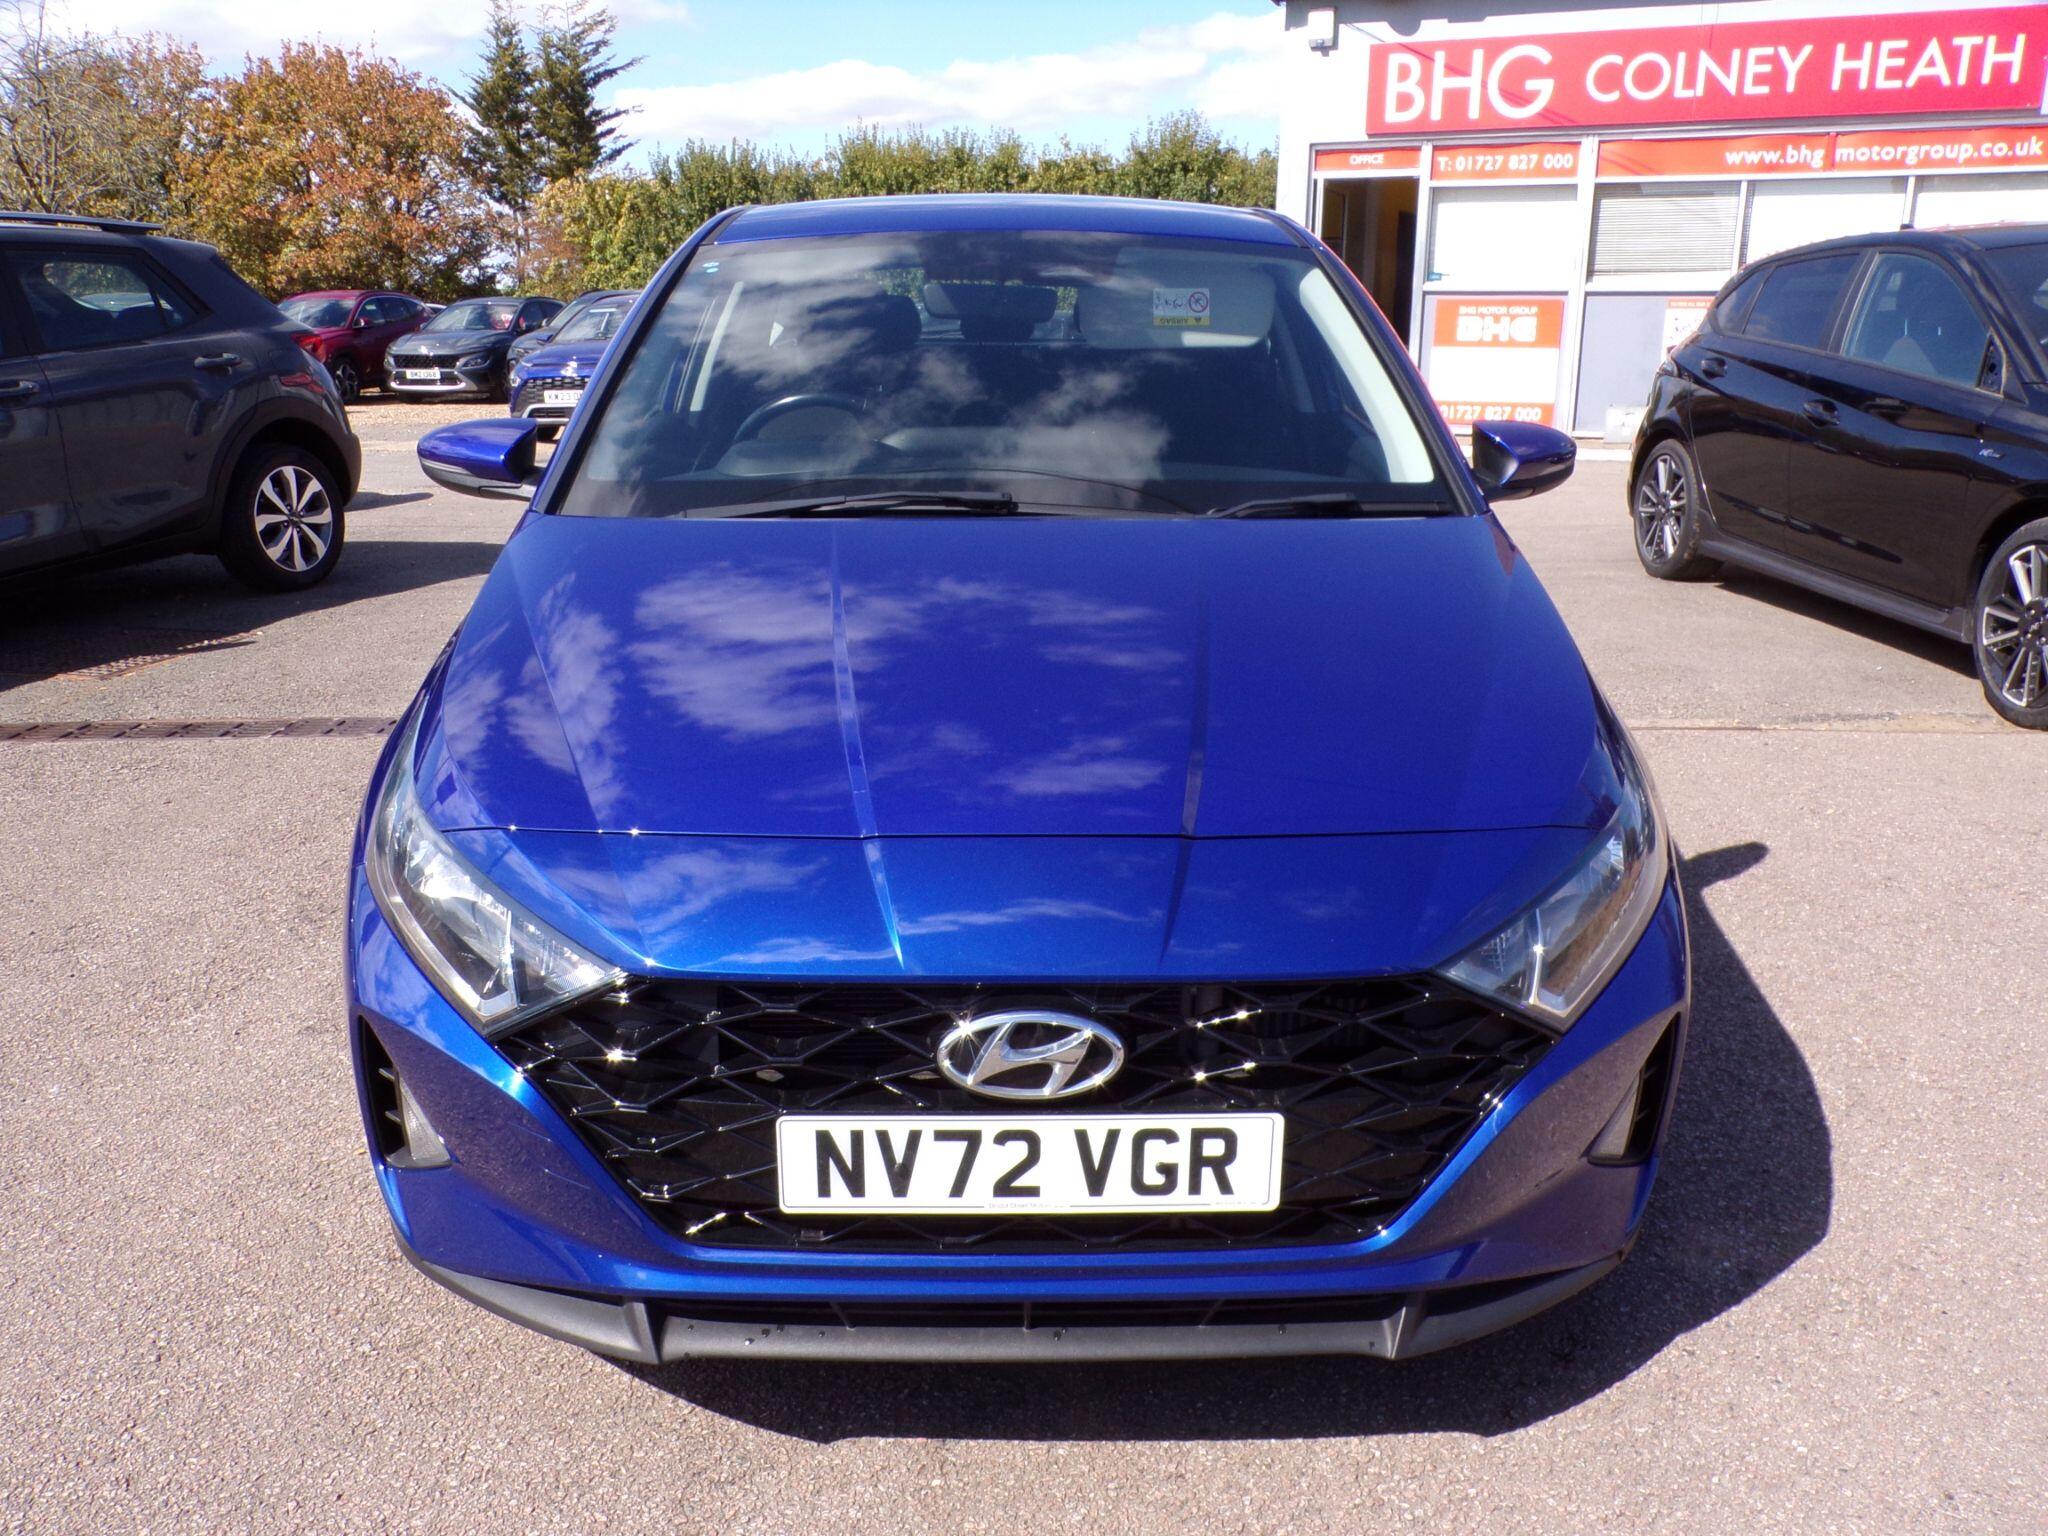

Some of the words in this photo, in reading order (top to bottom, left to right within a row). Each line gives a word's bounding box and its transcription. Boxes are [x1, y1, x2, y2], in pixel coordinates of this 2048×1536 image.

[1384, 44, 1555, 123] BHG
[1586, 45, 1813, 102] COLNEY
[1831, 33, 2027, 90] HEATH
[1349, 153, 1384, 165] OFFICE
[1437, 156, 1452, 172] T:
[1455, 155, 1504, 172] 01727
[1509, 154, 1538, 171] 827
[1543, 153, 1573, 170] 000
[1725, 143, 1824, 168] www.bhg
[1835, 136, 2044, 164] motorgroup.co.uk
[1456, 315, 1538, 342] BHG
[1439, 405, 1482, 420] 01727
[1485, 406, 1511, 421] 827
[1514, 407, 1542, 421] 000
[815, 1129, 1041, 1198] NV72
[1074, 1127, 1238, 1197] VGR
